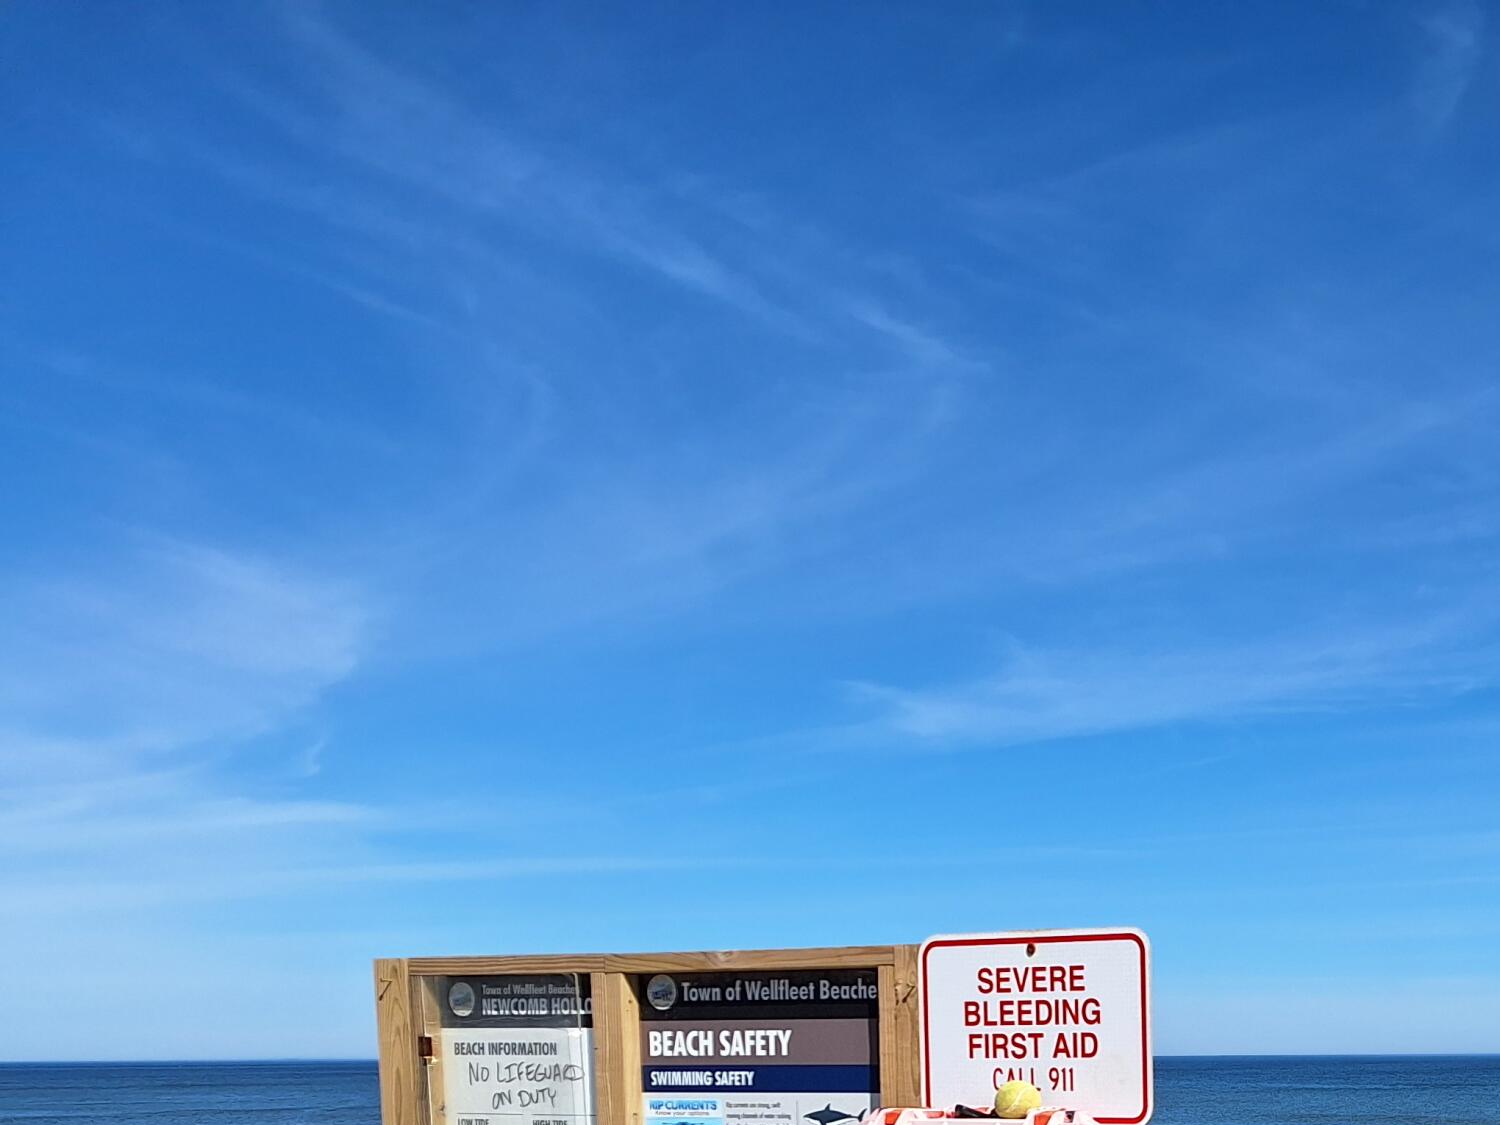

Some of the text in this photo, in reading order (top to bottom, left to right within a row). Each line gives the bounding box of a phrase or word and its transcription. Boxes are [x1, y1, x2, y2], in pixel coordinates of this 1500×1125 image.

[482, 983, 577, 994] Town of Wellfleet Beache
[681, 978, 877, 1001] Town of Wellfleet Beache
[977, 965, 1085, 994] SEVERE
[482, 997, 592, 1015] NEWCOMB HOLLO
[964, 998, 1101, 1027] BLEEDING
[454, 1042, 557, 1056] BEACH INFORMATION
[649, 1030, 792, 1057] BEACH SAFETY
[968, 1032, 1098, 1059] FIRST AID
[469, 1061, 585, 1085] NO LIFEGUARD
[650, 1071, 754, 1086] SWIMMING SAFETY
[1049, 1067, 1074, 1091] 911
[492, 1087, 557, 1110] ON DUTY
[665, 1100, 717, 1111] CURRENTS
